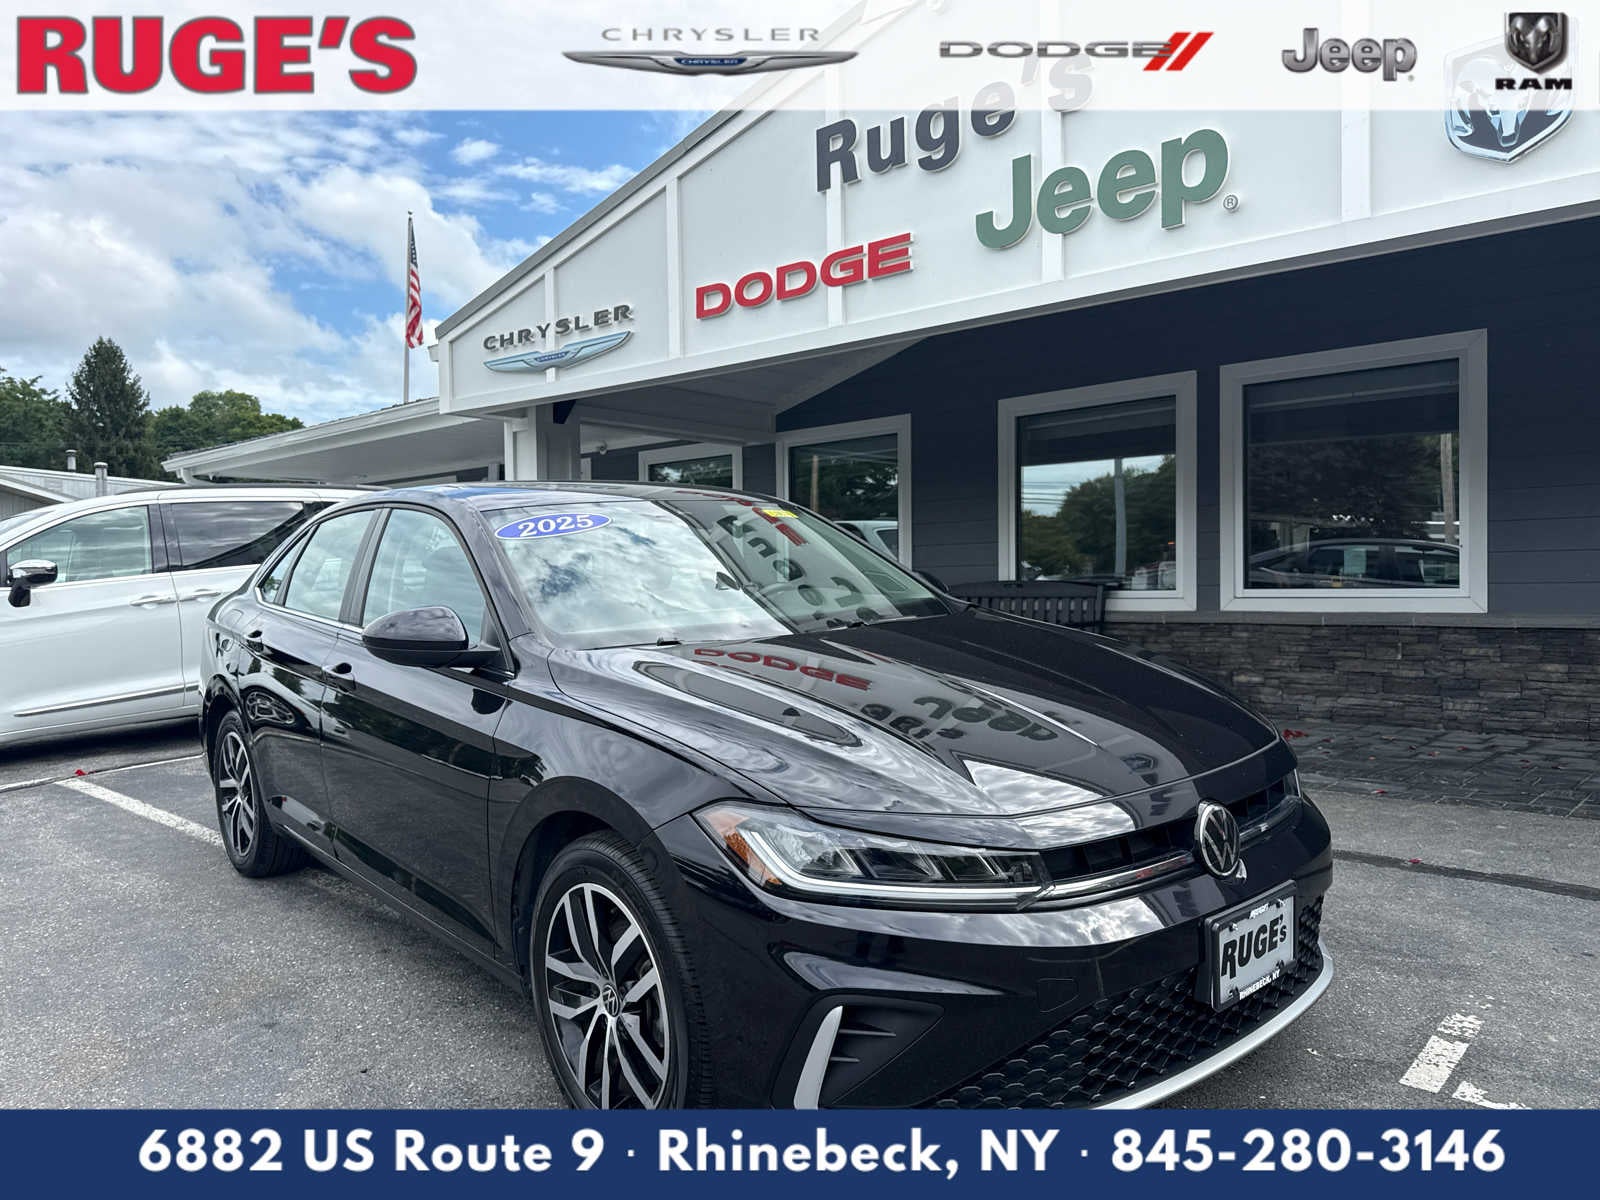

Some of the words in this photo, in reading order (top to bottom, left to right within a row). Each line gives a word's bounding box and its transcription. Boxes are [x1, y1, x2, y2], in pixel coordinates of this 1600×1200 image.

[976, 128, 1229, 249] Jeep
[695, 232, 912, 319] DODGE
[483, 304, 633, 351] CHRYSLER
[518, 515, 594, 538] 2025
[1271, 968, 1281, 981] NY
